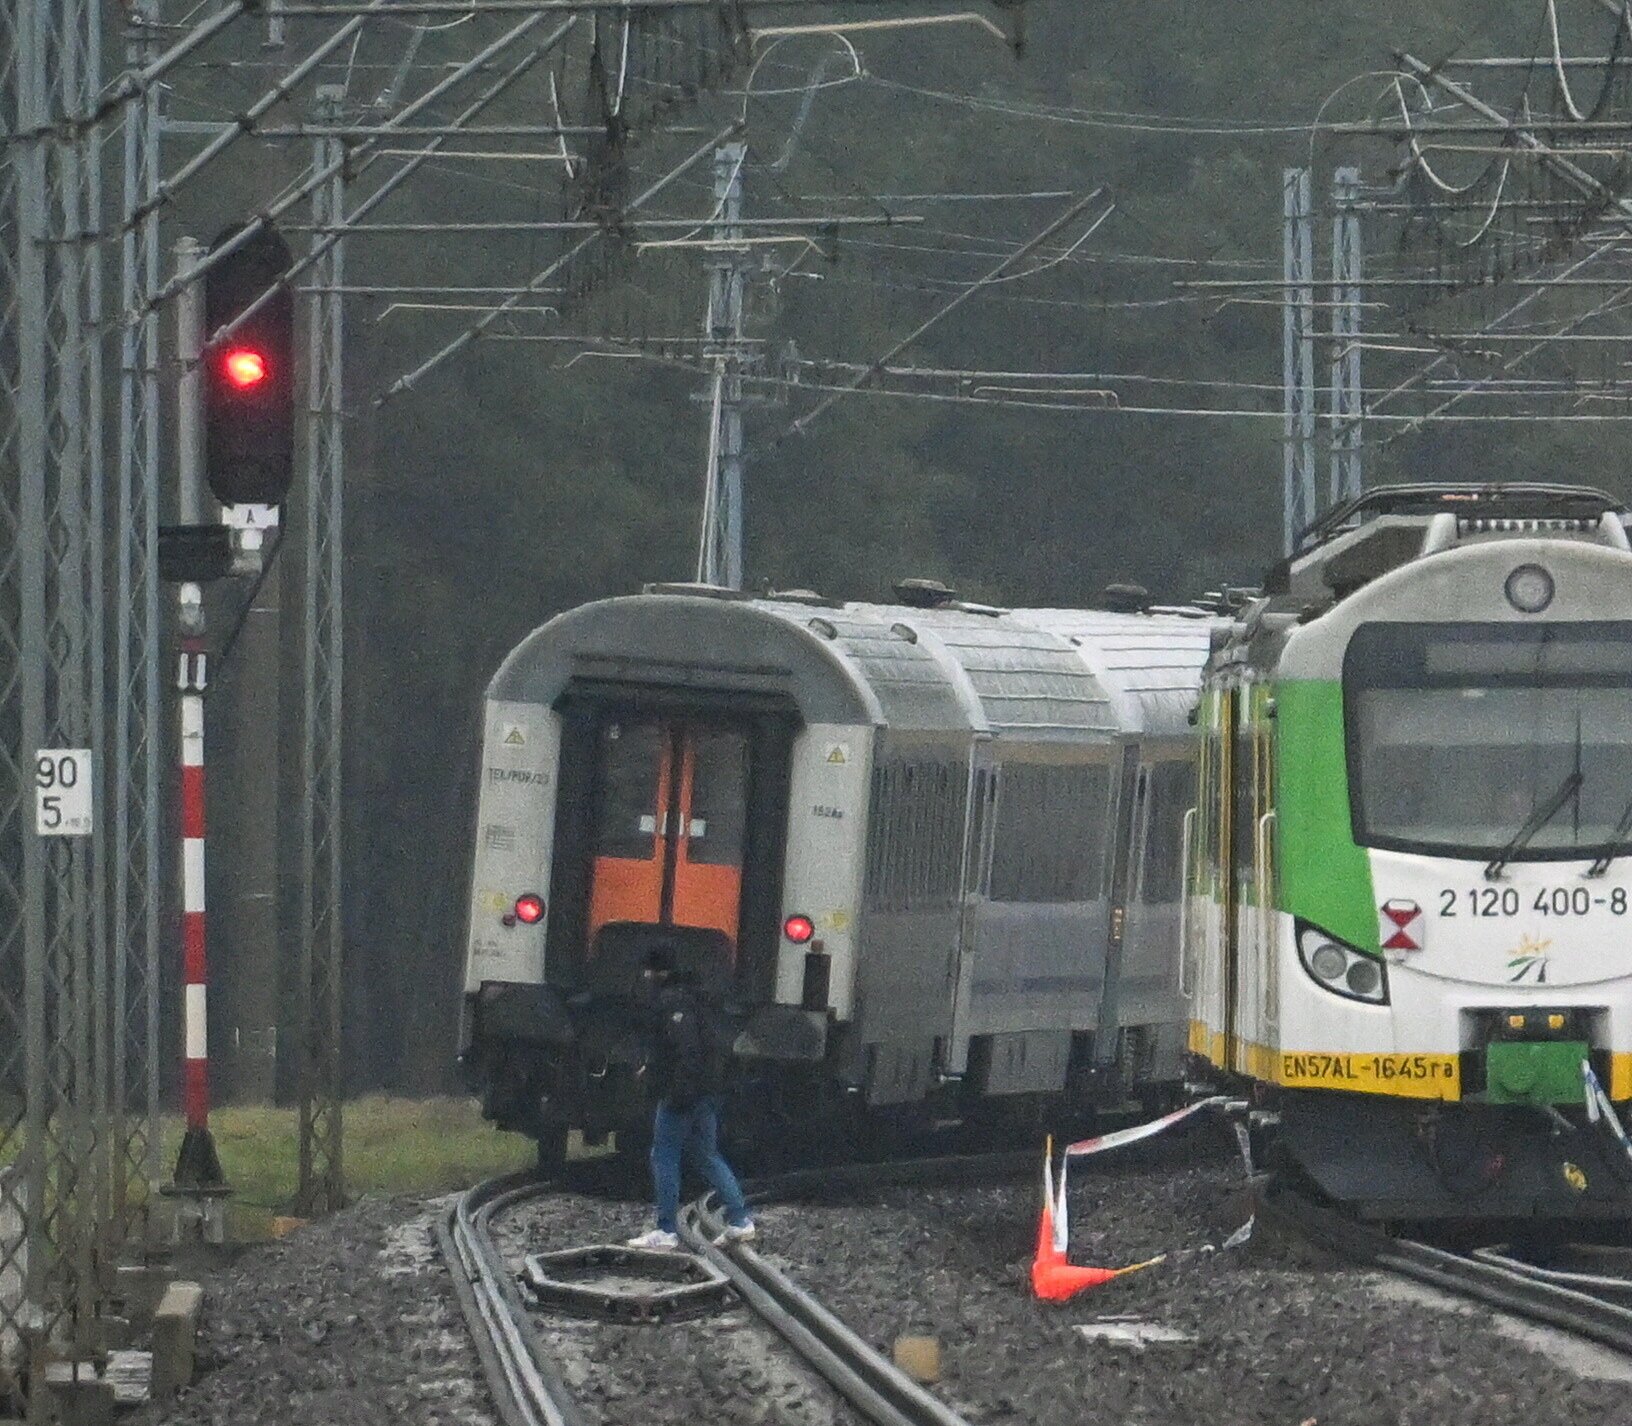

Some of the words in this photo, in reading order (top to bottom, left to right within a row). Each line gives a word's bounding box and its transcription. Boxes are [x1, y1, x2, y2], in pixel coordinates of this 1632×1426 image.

[246, 508, 256, 524] A
[38, 756, 78, 788] 90
[43, 796, 62, 828] 5
[1439, 888, 1457, 917] 2
[1469, 888, 1520, 917] 120
[1533, 887, 1628, 916] 400-8
